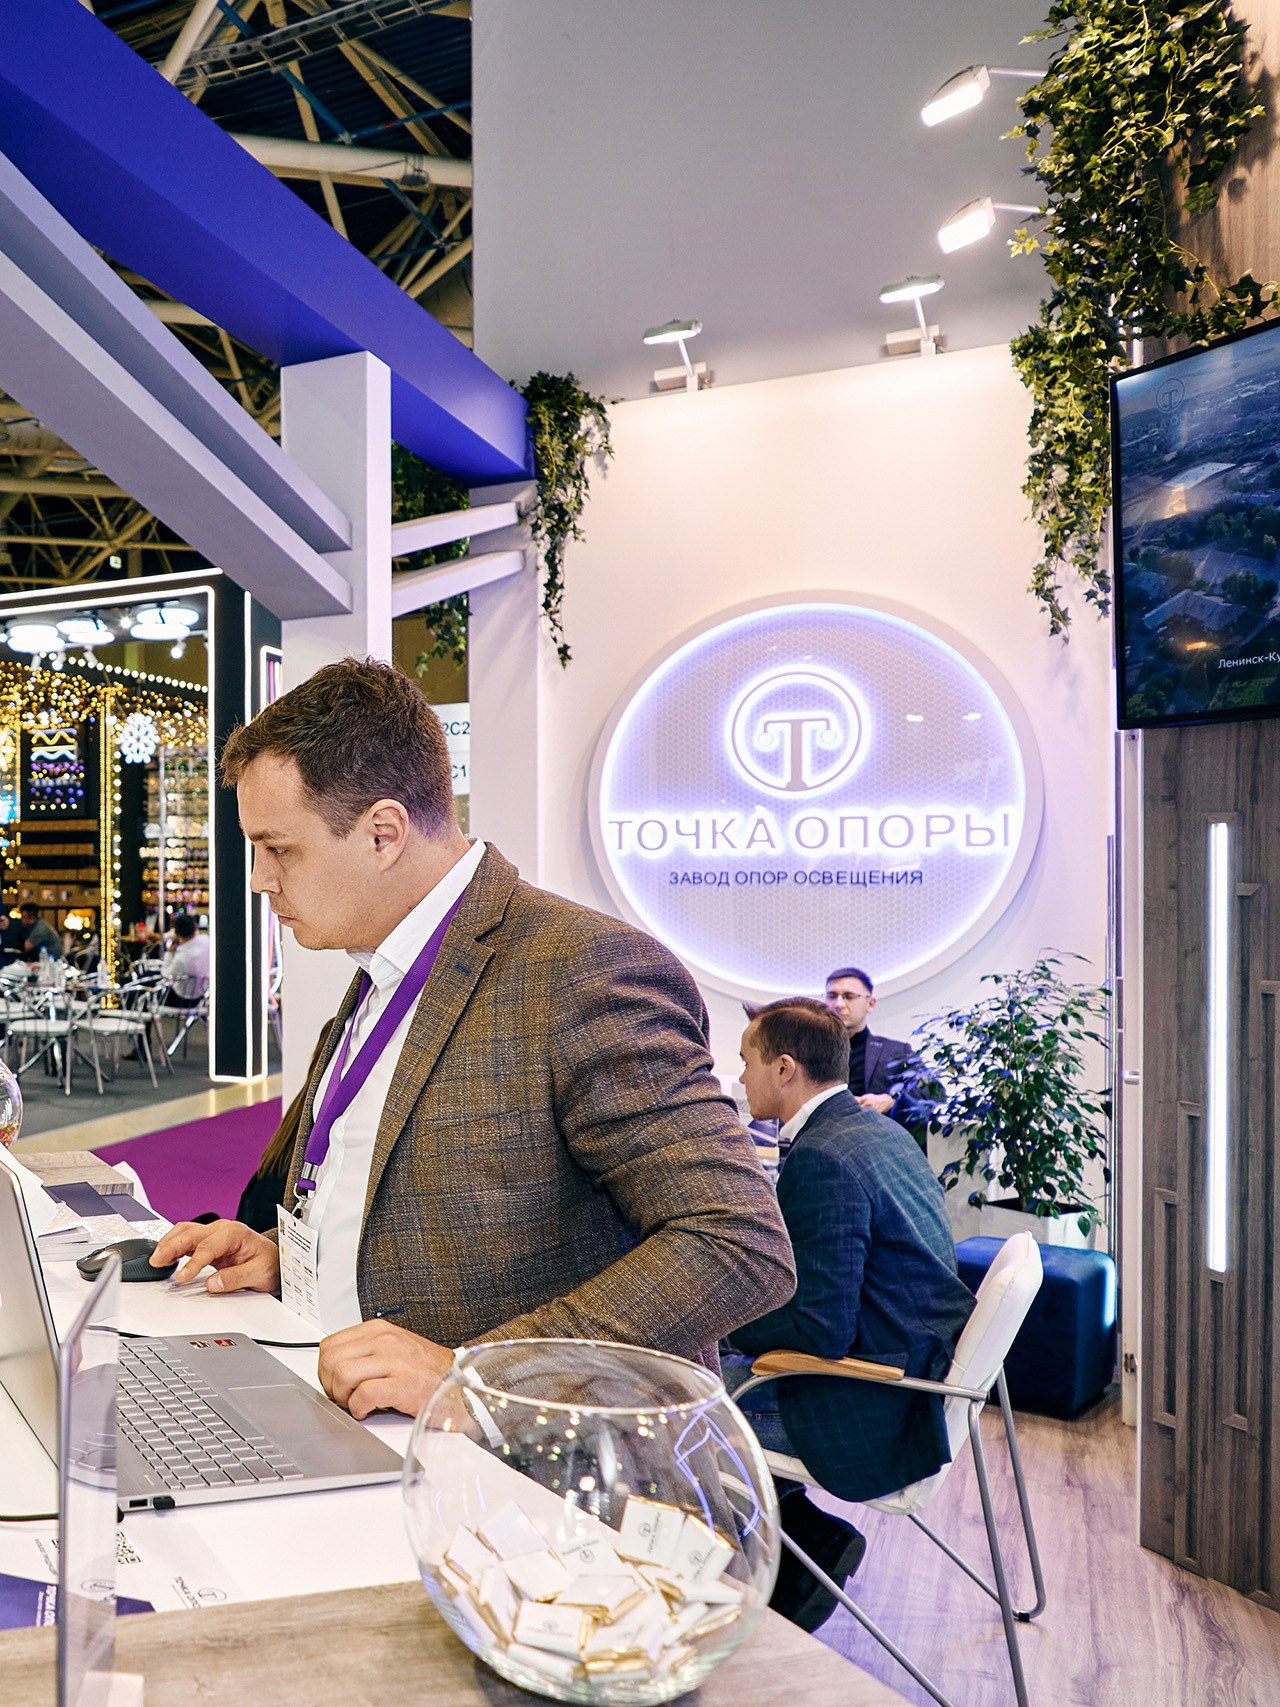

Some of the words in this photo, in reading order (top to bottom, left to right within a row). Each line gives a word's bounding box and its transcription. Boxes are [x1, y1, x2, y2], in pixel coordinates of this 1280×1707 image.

[608, 817, 777, 851] ТОЧКА
[794, 813, 1010, 849] ОПОРЫ
[669, 870, 730, 888] ЗАВОД
[735, 870, 788, 886] ОПОР
[793, 869, 924, 888] ОСВЕЩЕНИЯ
